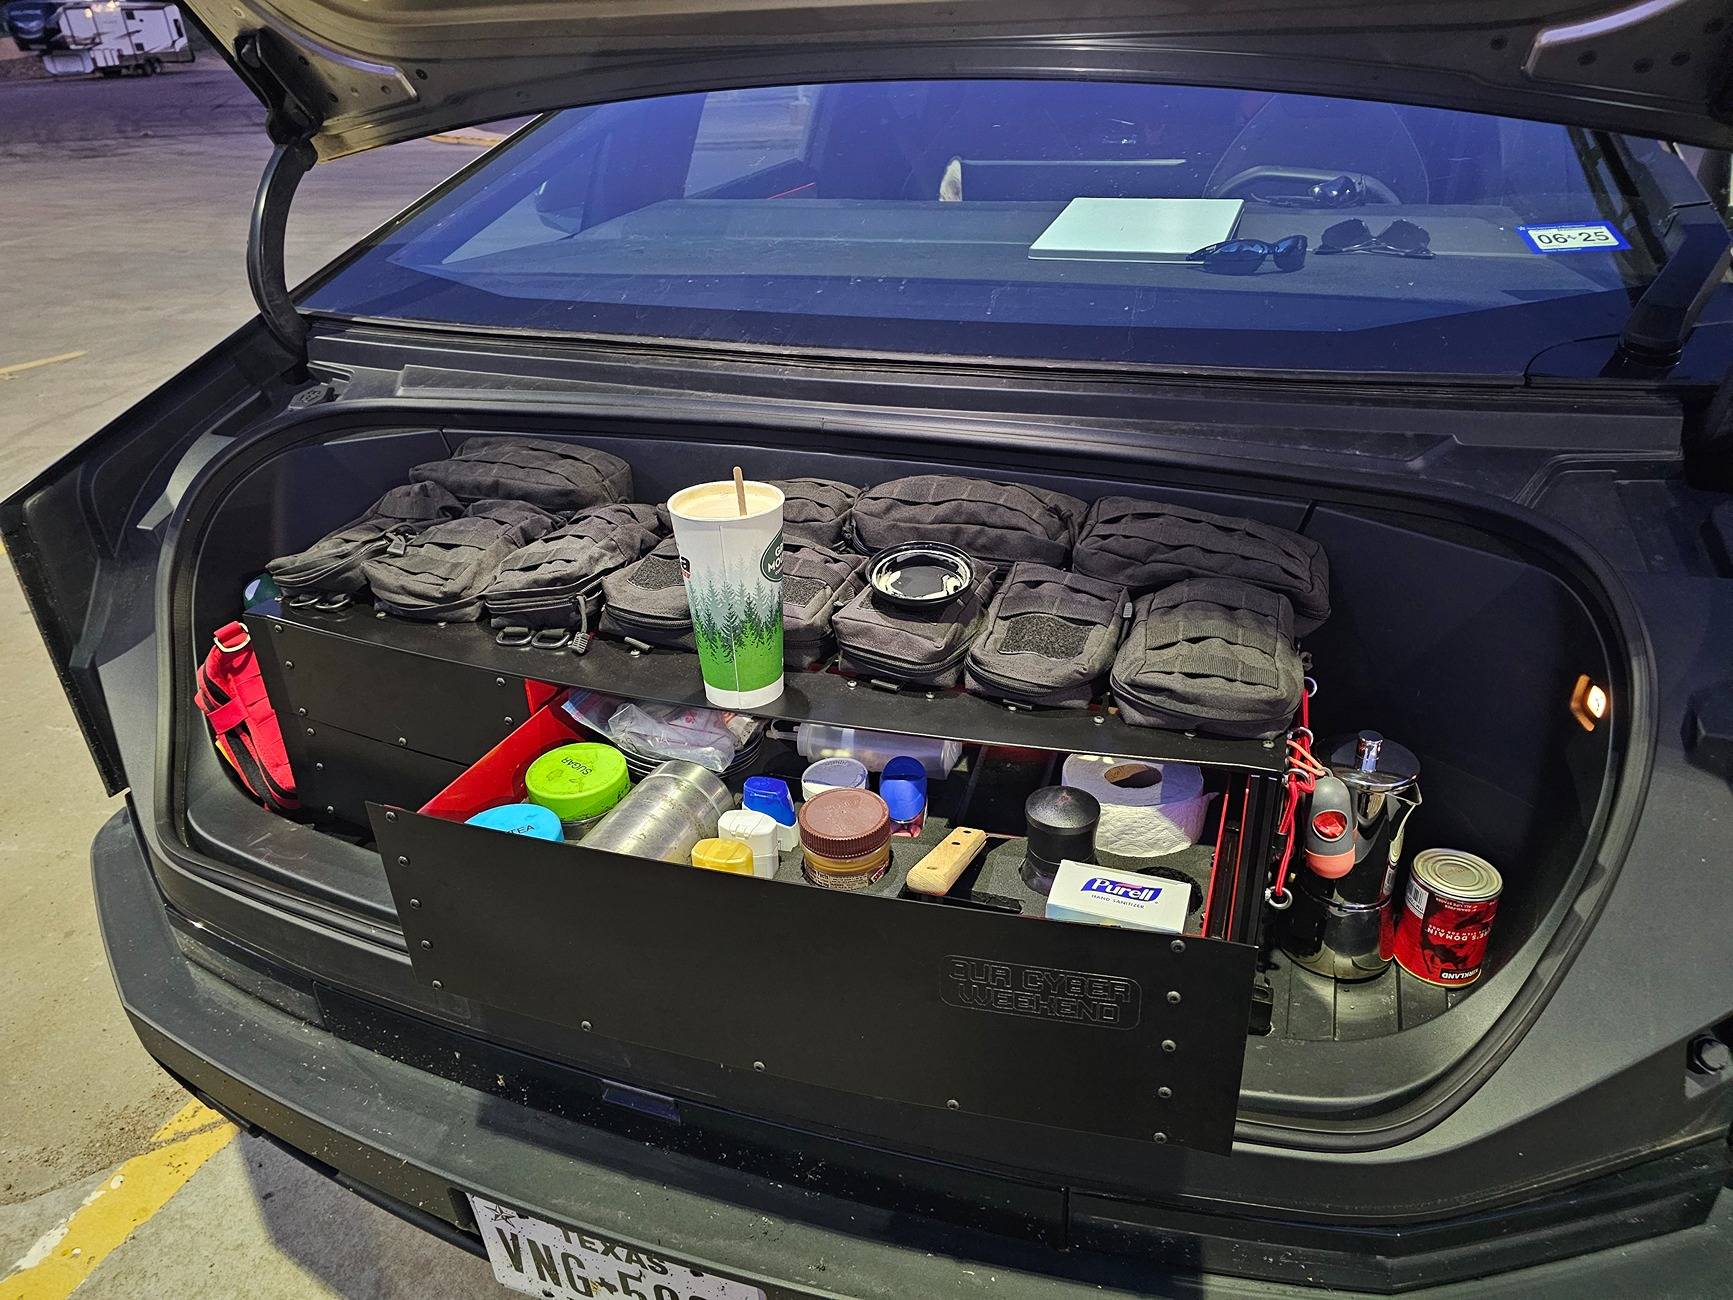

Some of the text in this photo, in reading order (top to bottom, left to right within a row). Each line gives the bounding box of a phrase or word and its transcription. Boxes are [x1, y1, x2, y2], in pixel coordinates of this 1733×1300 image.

[561, 756, 593, 776] SUGAR
[1091, 894, 1145, 909] HAND SANITIZER
[1427, 927, 1468, 941] DOMAIN
[949, 959, 1131, 1003] OUR CYBER
[958, 983, 1121, 1024] WEEKEND
[561, 1227, 669, 1276] TEXAS
